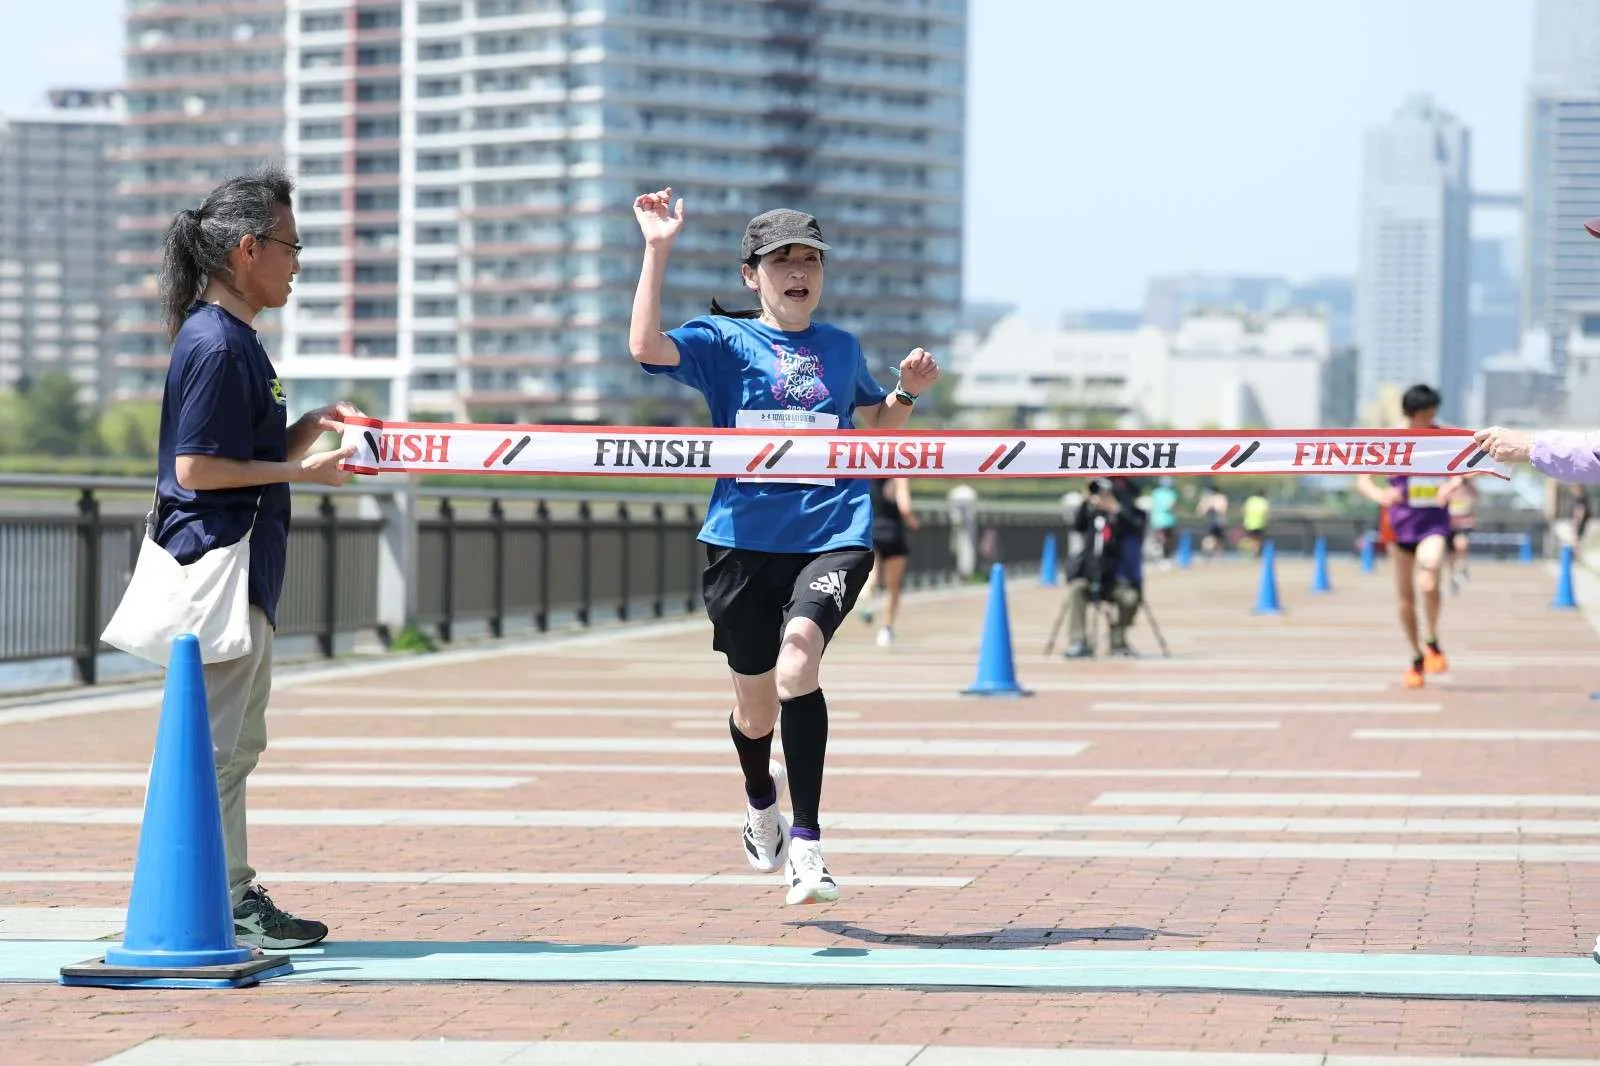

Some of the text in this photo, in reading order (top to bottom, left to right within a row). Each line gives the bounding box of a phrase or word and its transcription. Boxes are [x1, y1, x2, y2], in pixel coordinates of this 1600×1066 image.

[593, 438, 714, 468] FINISH
[826, 441, 947, 470] FINISH
[1058, 442, 1180, 470] FINISH
[1291, 441, 1417, 467] FINISH
